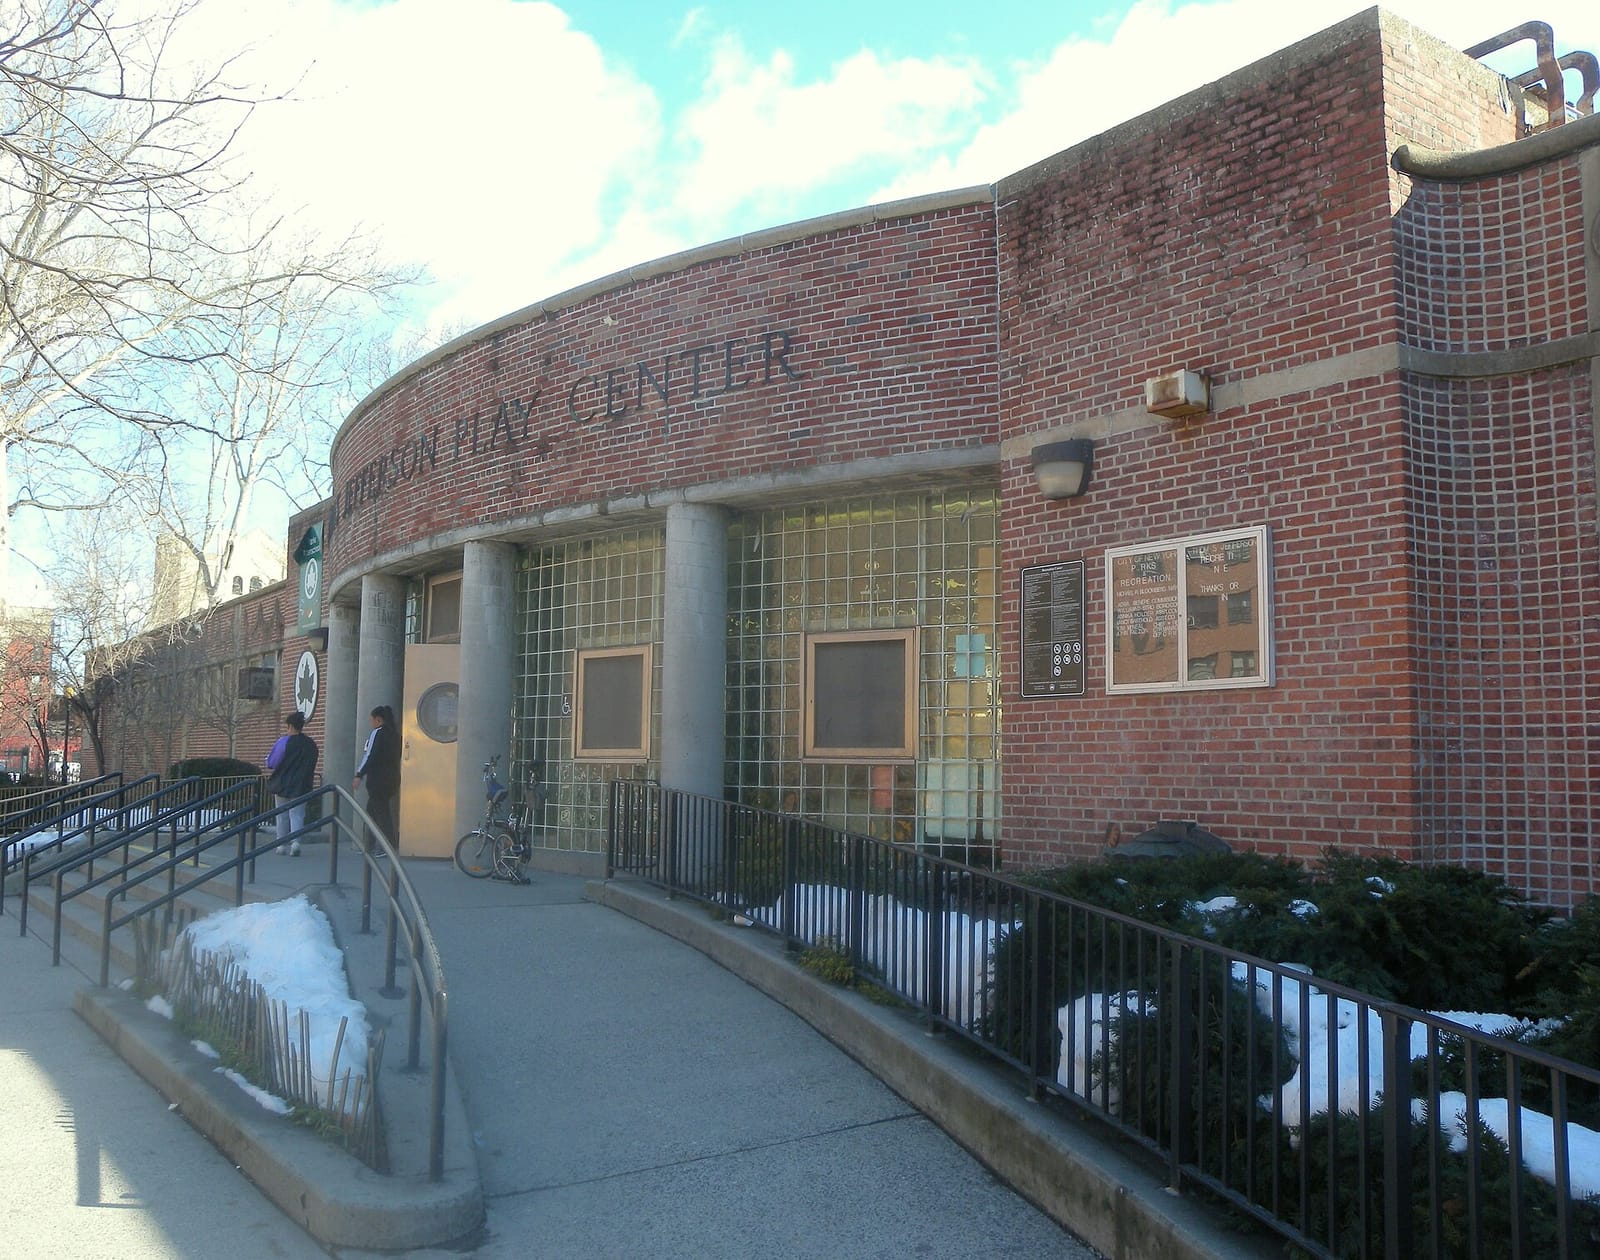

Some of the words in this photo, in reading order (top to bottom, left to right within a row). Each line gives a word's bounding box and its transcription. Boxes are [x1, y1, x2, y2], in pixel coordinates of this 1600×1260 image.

[453, 389, 541, 462] PLAY
[568, 330, 806, 424] CENTER
[1120, 574, 1171, 587] RECREATION
